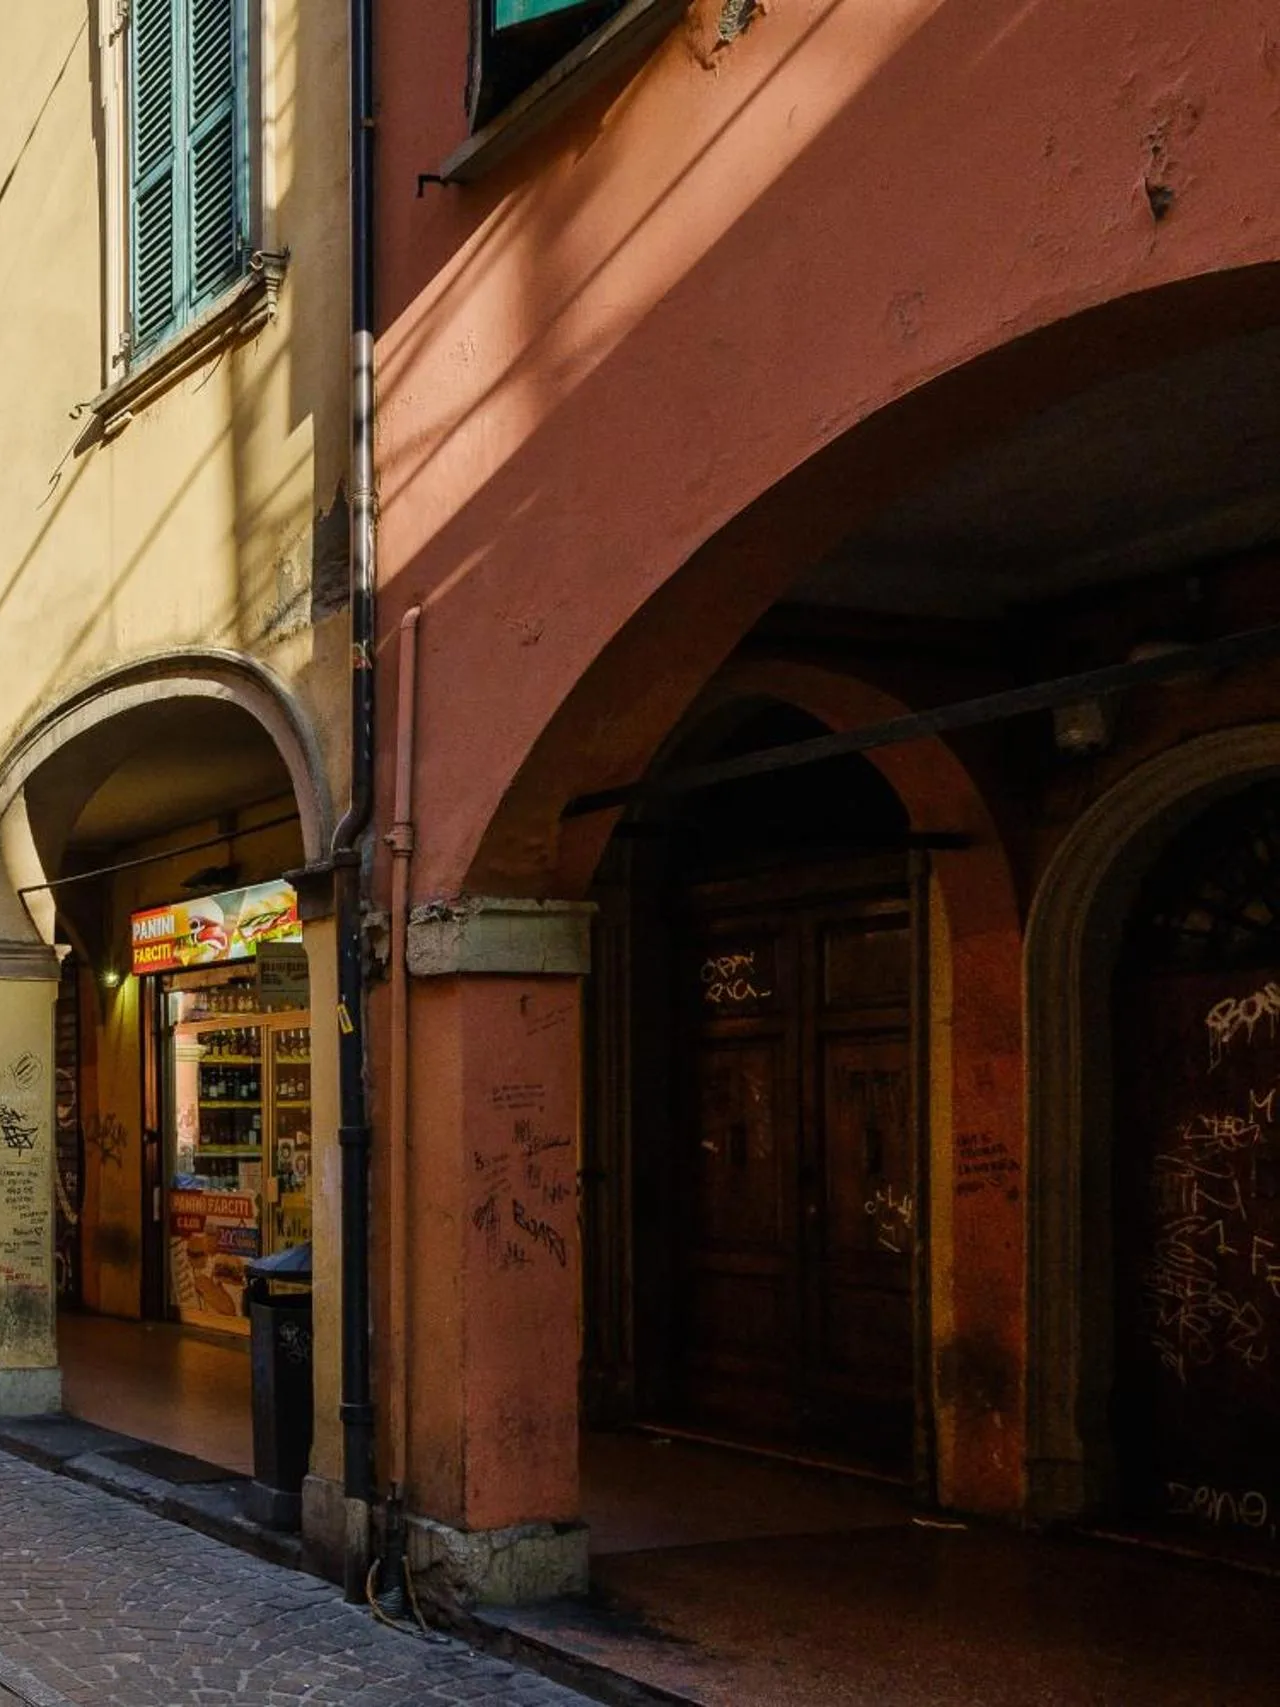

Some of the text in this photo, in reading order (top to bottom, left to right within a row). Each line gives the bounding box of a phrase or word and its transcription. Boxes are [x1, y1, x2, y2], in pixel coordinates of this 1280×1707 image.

[132, 914, 176, 941] PANINI
[133, 943, 171, 964] FARCITI
[208, 1197, 249, 1216] FARCITI
